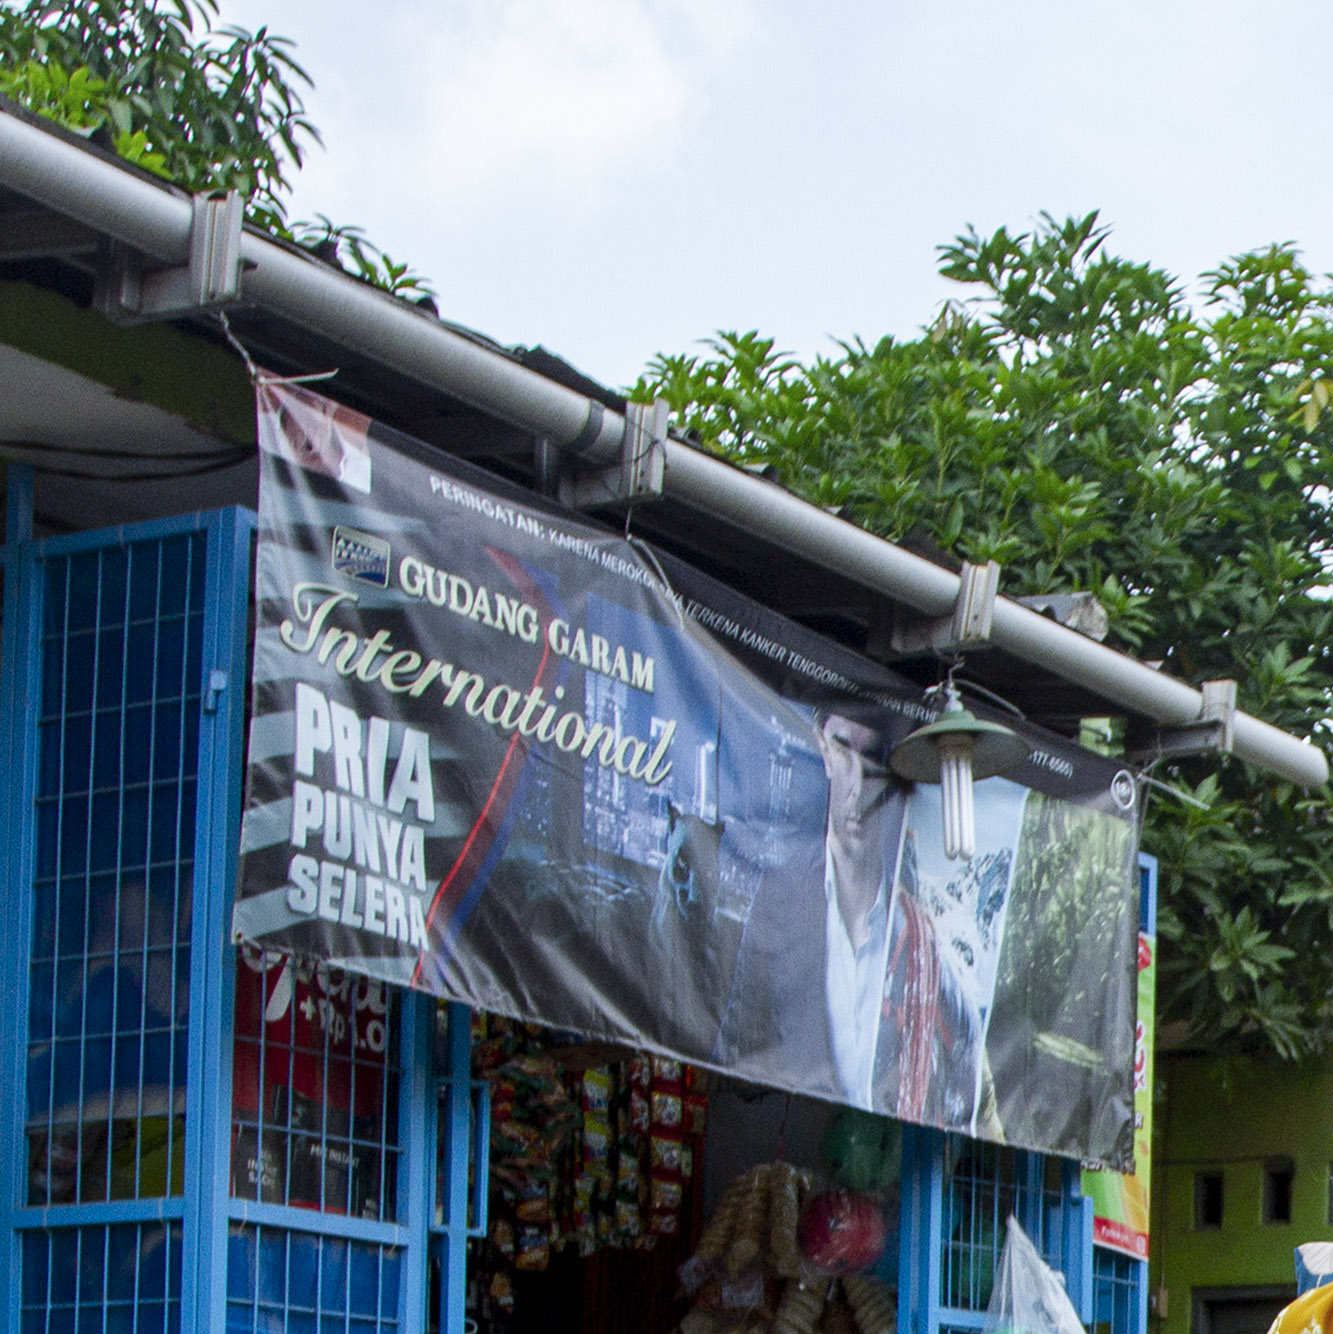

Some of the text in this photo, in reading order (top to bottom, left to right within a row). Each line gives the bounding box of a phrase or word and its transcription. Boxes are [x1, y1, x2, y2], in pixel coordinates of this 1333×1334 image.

[399, 555, 655, 694] GUDANG GARAM
[429, 474, 545, 539] PERINGATAN:
[547, 527, 600, 563] KARENA
[685, 599, 740, 639] TERKENA
[740, 627, 787, 661] KANKER
[279, 581, 678, 786] International
[294, 681, 435, 823] PRIA
[286, 853, 430, 952] SELERA
[290, 779, 428, 892] PUNYA
